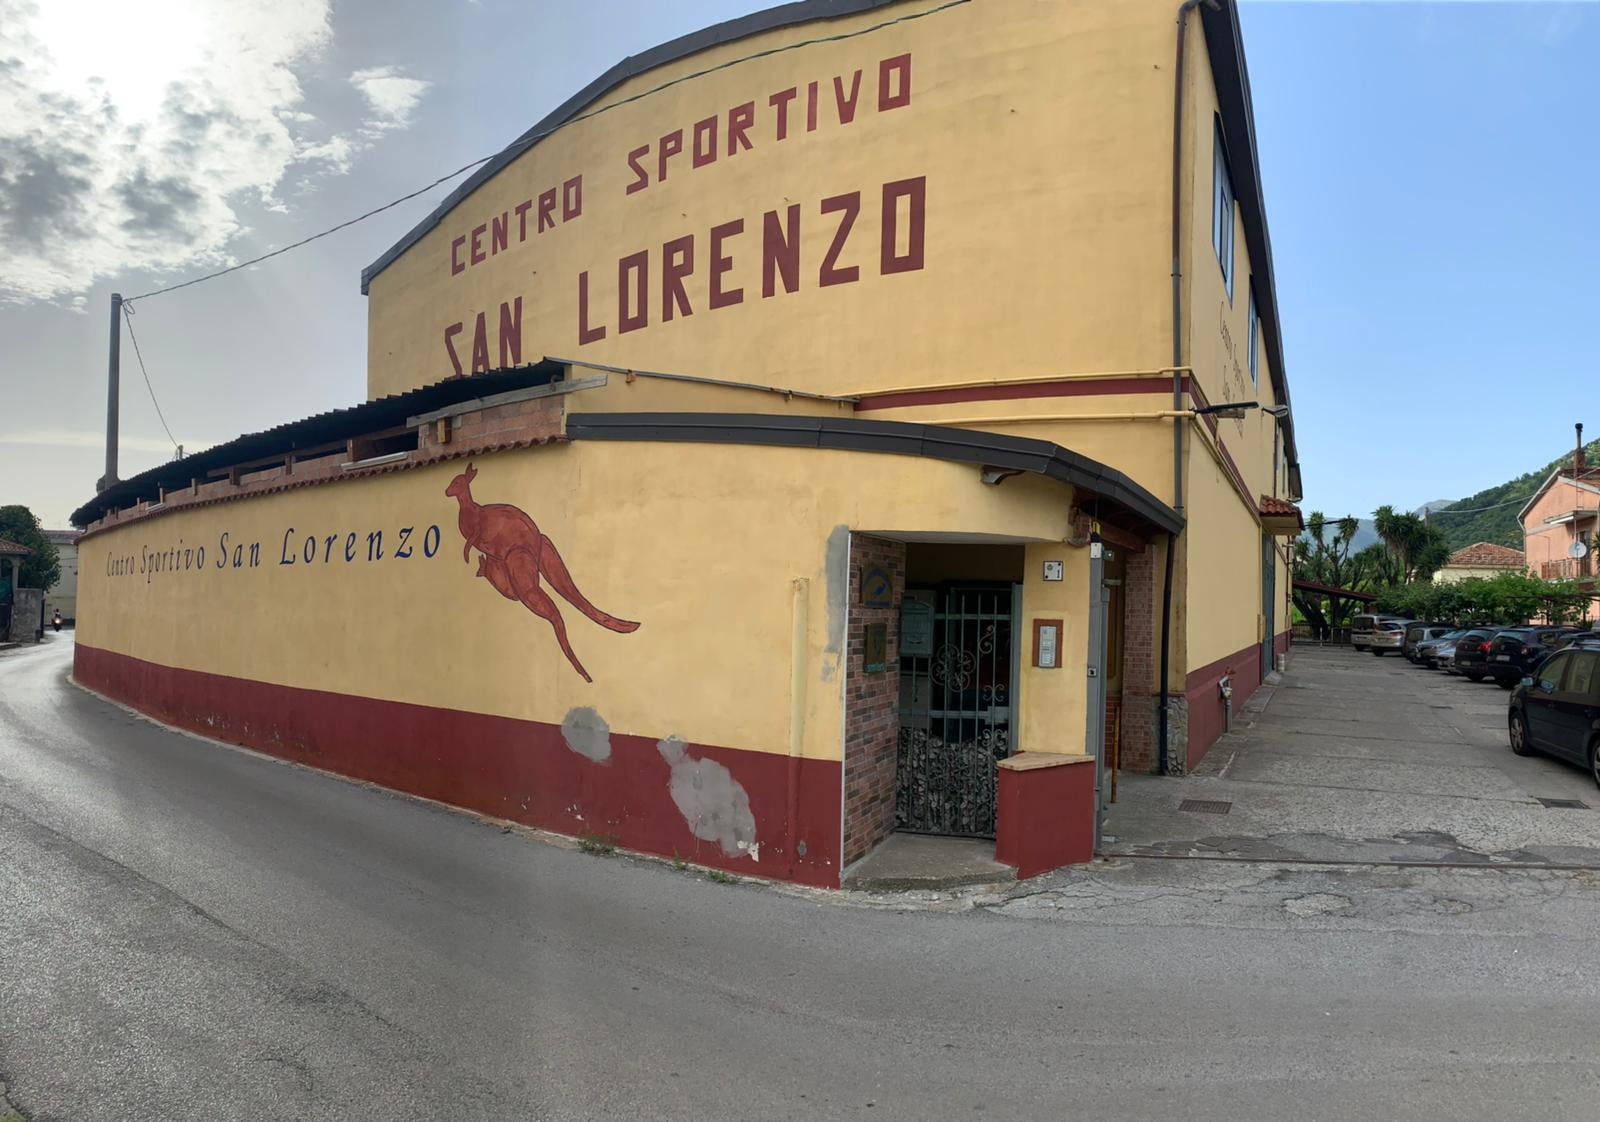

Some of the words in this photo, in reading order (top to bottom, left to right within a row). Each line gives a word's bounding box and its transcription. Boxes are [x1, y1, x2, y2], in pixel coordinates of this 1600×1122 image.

[451, 174, 583, 277] CENTRO
[626, 52, 912, 196] SPORTIVO
[444, 296, 522, 378] SAN
[578, 175, 927, 346] LORENZO
[106, 551, 135, 577] Centro
[140, 539, 205, 584] Sportivo
[216, 532, 261, 570] San
[279, 524, 442, 565] Lorenzo
